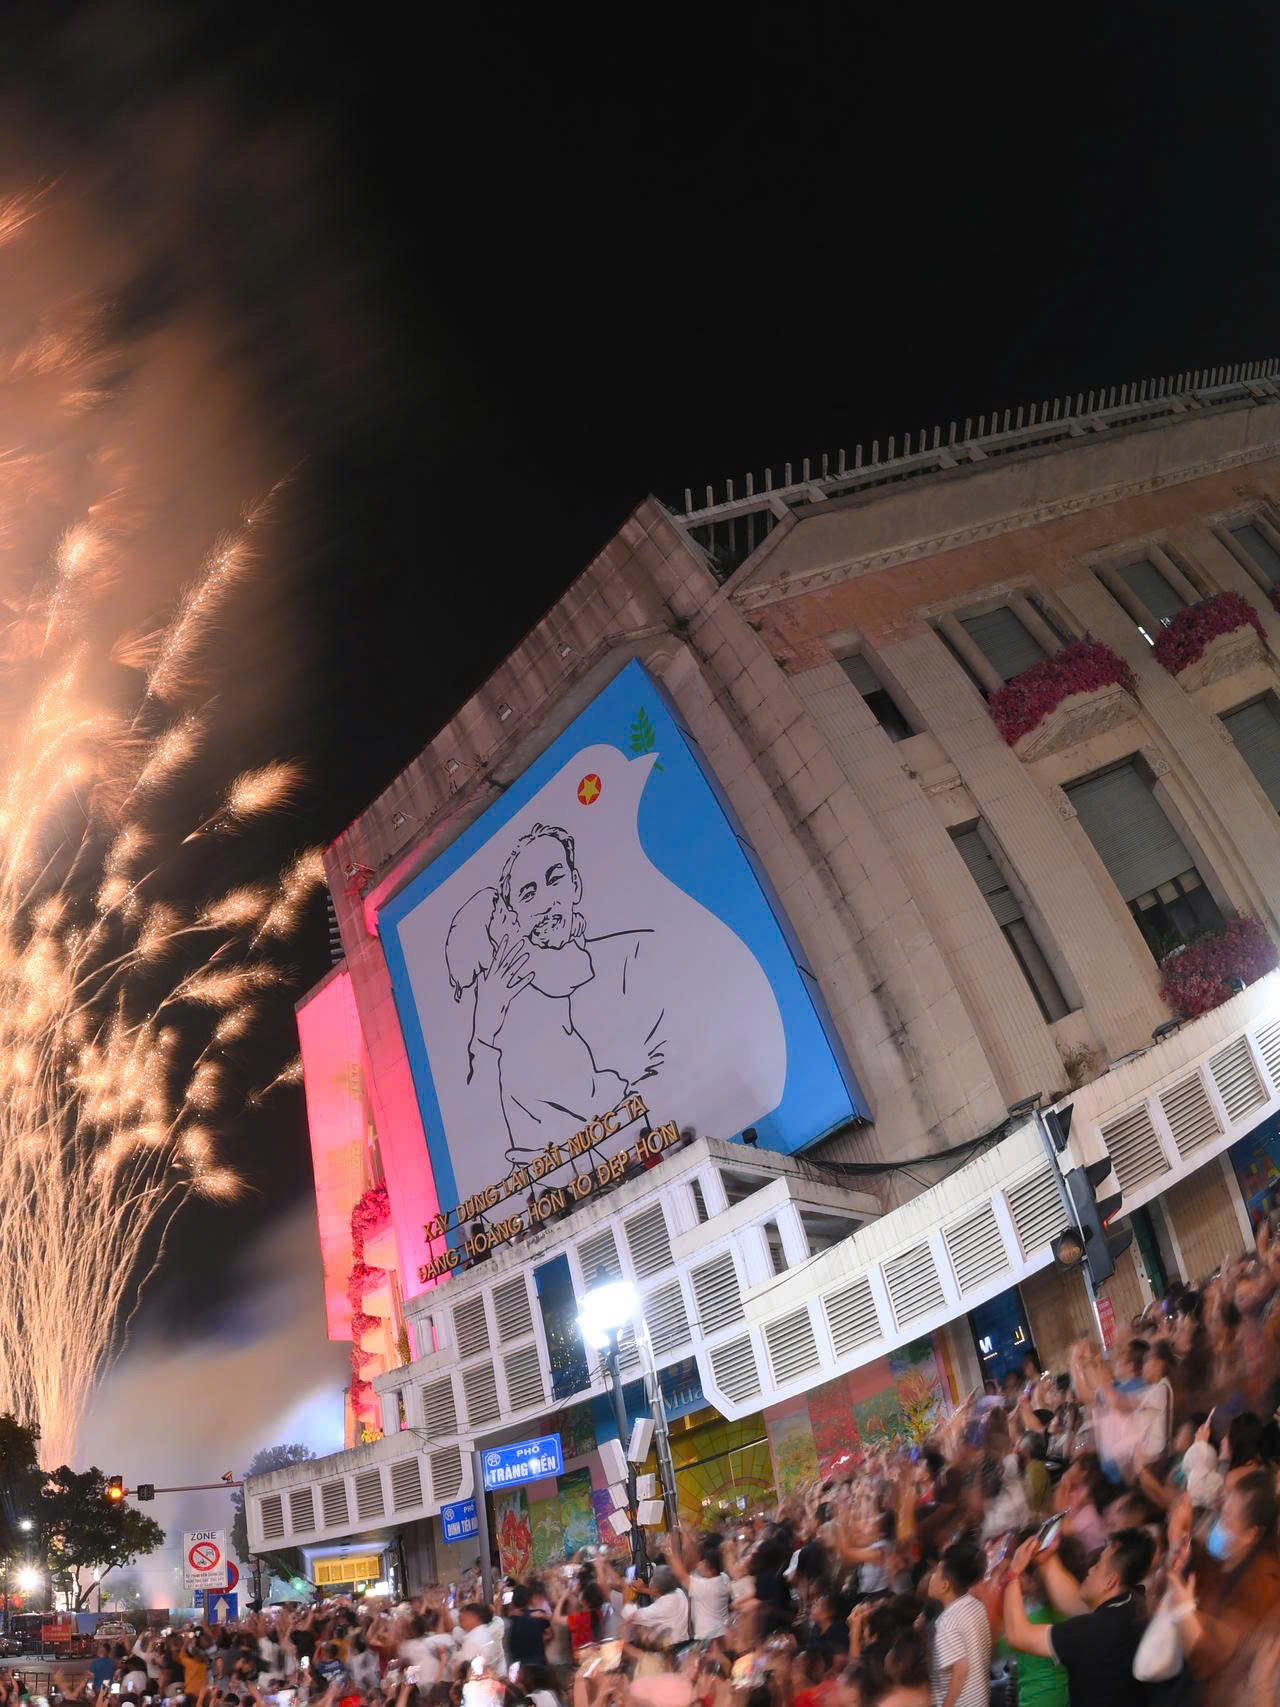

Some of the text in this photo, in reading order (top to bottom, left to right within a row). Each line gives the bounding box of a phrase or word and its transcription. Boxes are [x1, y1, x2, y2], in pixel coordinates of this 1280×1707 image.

[424, 1211, 450, 1241] XÂY
[501, 1167, 530, 1195] LẠI
[532, 1141, 564, 1178] ĐẤT
[624, 1094, 648, 1121] TA
[570, 1173, 593, 1200] TO
[597, 1151, 630, 1186] ĐẸP
[635, 1120, 681, 1162] HƠN
[516, 1442, 540, 1458] PHỐ
[489, 1462, 528, 1483] TRÀNG
[191, 1532, 217, 1541] ZONE
